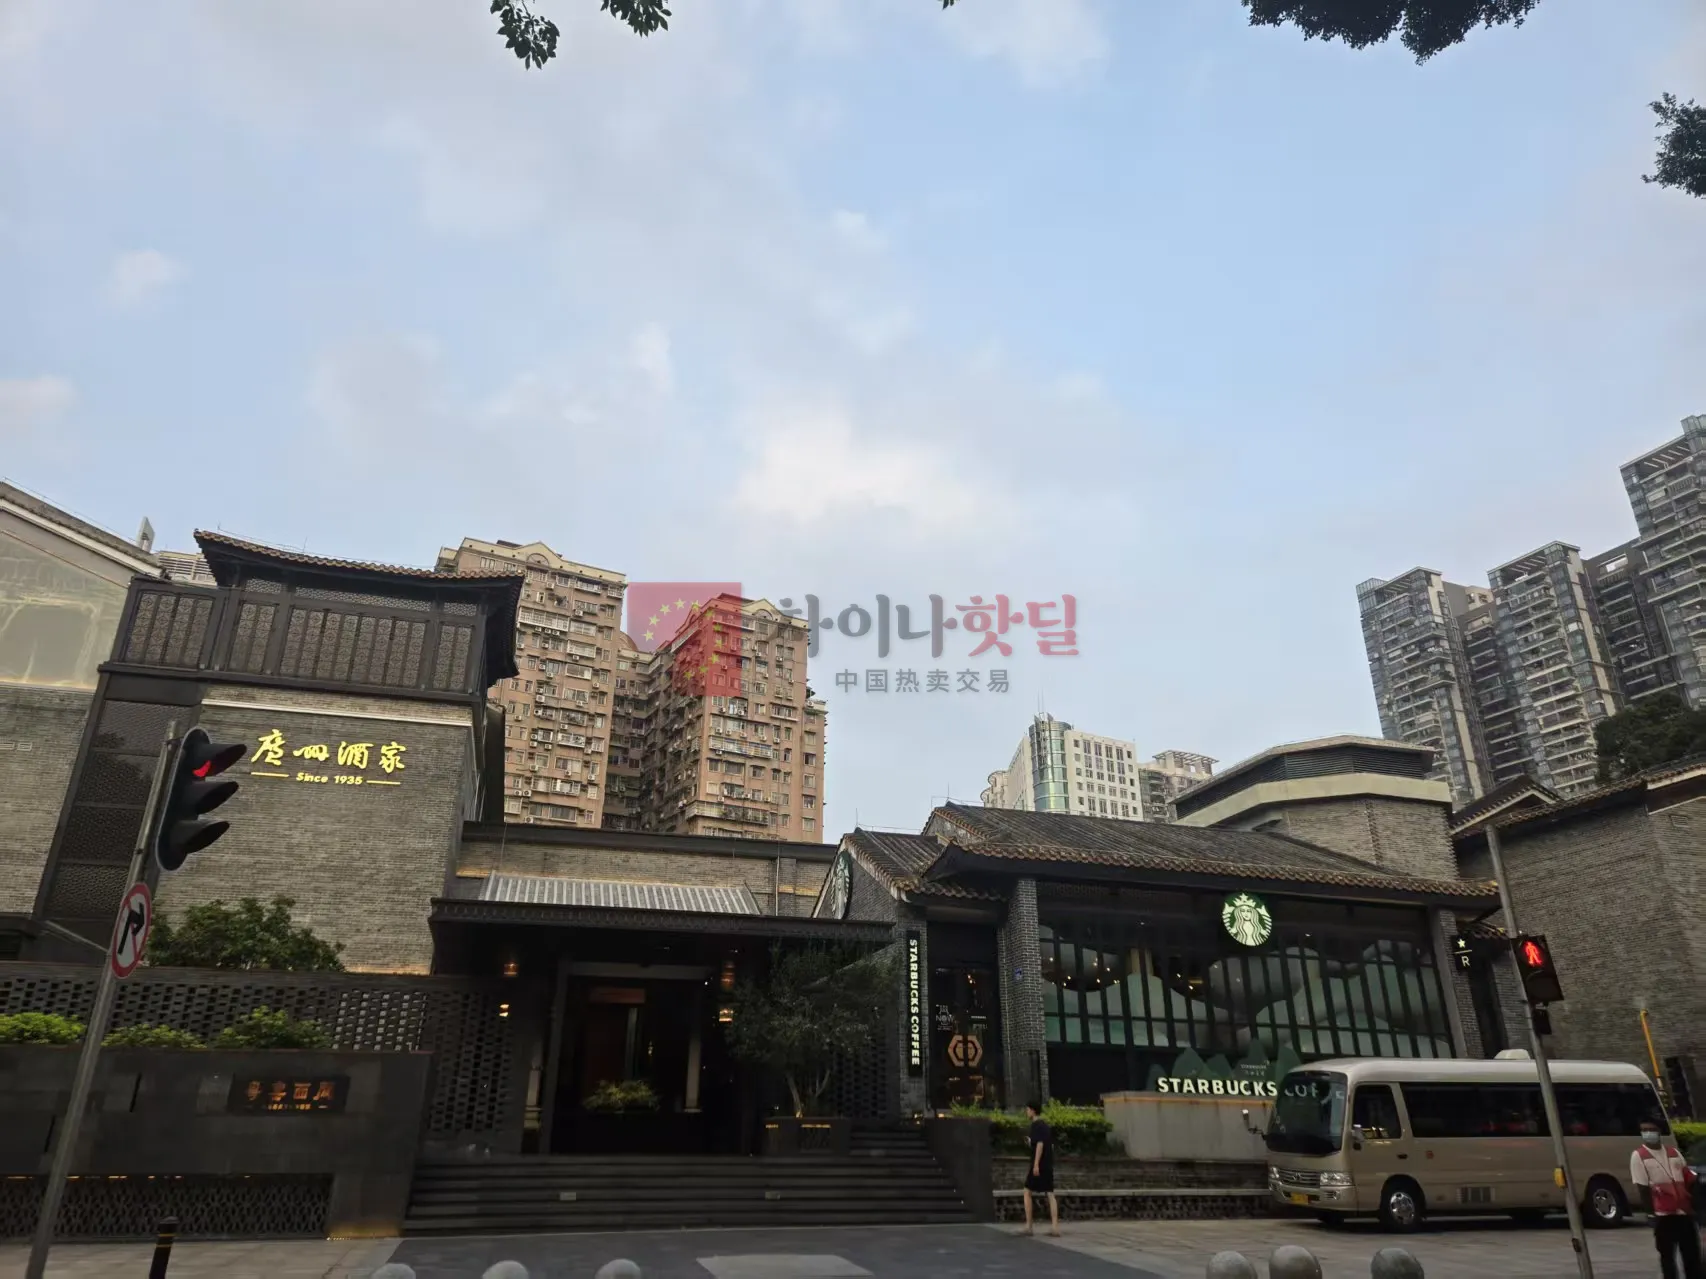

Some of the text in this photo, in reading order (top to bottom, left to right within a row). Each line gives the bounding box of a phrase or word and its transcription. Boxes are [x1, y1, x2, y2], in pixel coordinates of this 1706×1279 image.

[296, 772, 363, 785] Since 1935
[1461, 955, 1470, 967] R
[909, 938, 920, 1066] STARBUCKS COFFEE
[1157, 1077, 1278, 1097] STARBUCKS
